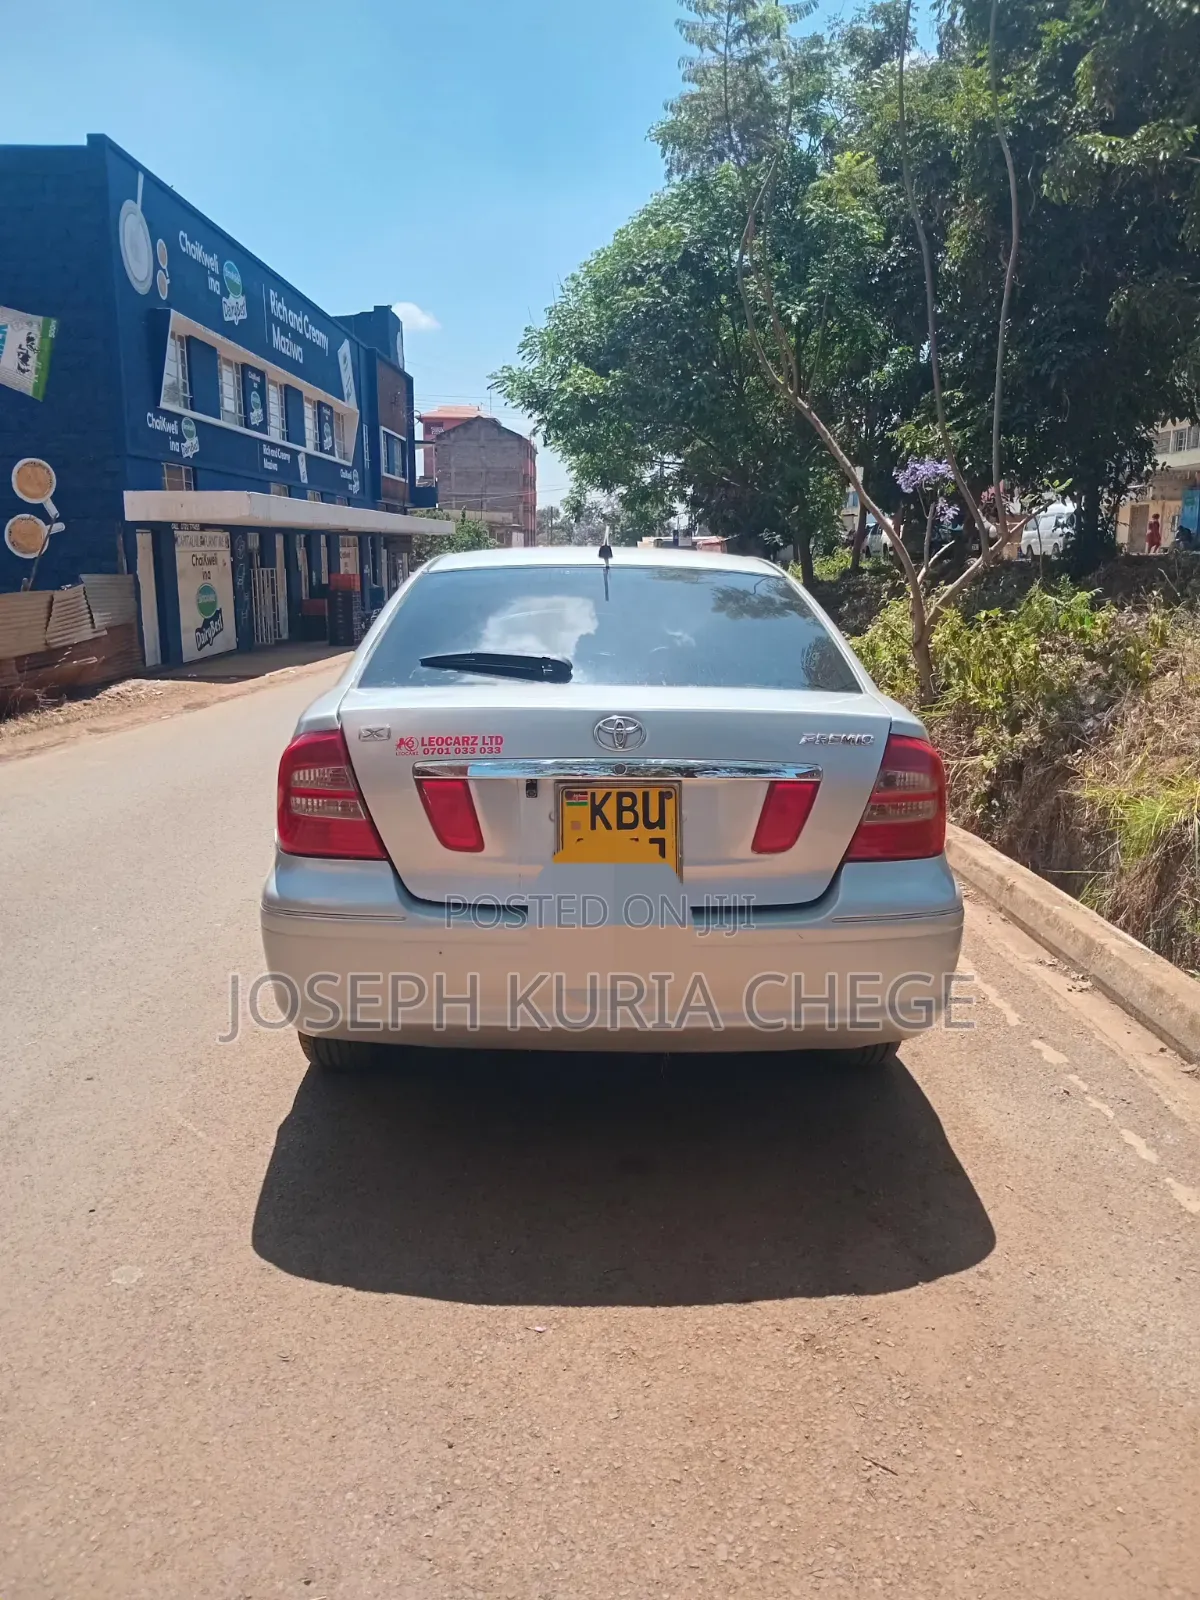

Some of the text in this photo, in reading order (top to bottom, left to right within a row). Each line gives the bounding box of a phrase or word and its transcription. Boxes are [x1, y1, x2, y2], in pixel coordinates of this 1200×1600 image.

[179, 230, 219, 274] ChaiKweli
[208, 270, 220, 295] ina
[270, 289, 329, 356] Rich and Creamy
[272, 323, 303, 364] Maziwa
[146, 412, 179, 435] ChaiKweli
[169, 436, 180, 453] ina
[195, 613, 223, 650] DairyBest
[421, 735, 504, 747] LEOCARZ LTD
[422, 746, 502, 756] 0701 033 033
[590, 791, 666, 830] KBU
